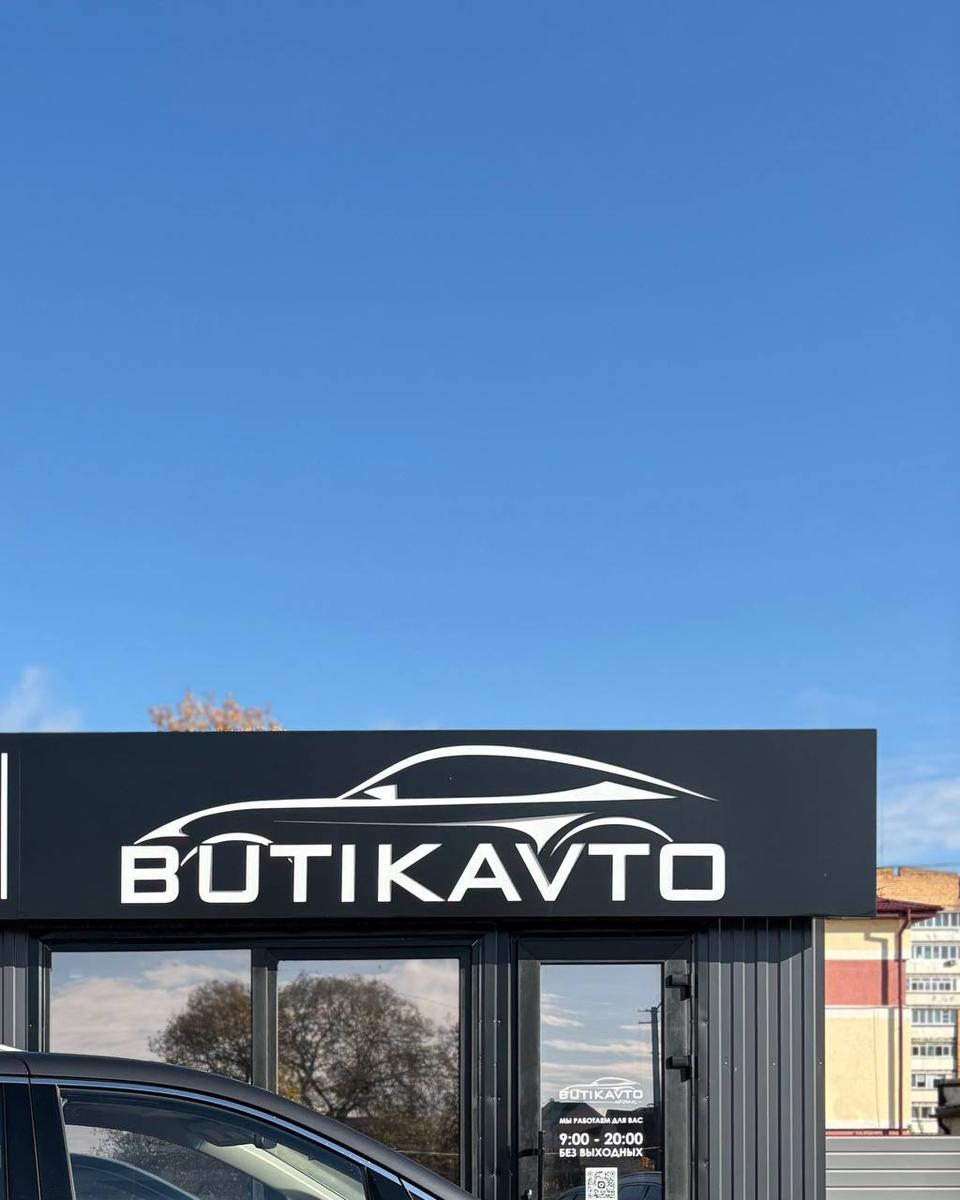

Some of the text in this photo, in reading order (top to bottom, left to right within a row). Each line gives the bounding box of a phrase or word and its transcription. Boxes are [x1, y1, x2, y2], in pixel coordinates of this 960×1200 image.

[120, 842, 727, 904] BUTIKAVTO
[559, 1089, 643, 1100] BUTIKAVTO
[611, 1117, 627, 1125] ДЛЯ
[559, 1132, 590, 1146] 9:00
[603, 1132, 644, 1146] 20:00
[559, 1147, 644, 1158] БЕЗ ВЫХОДНЫХ
